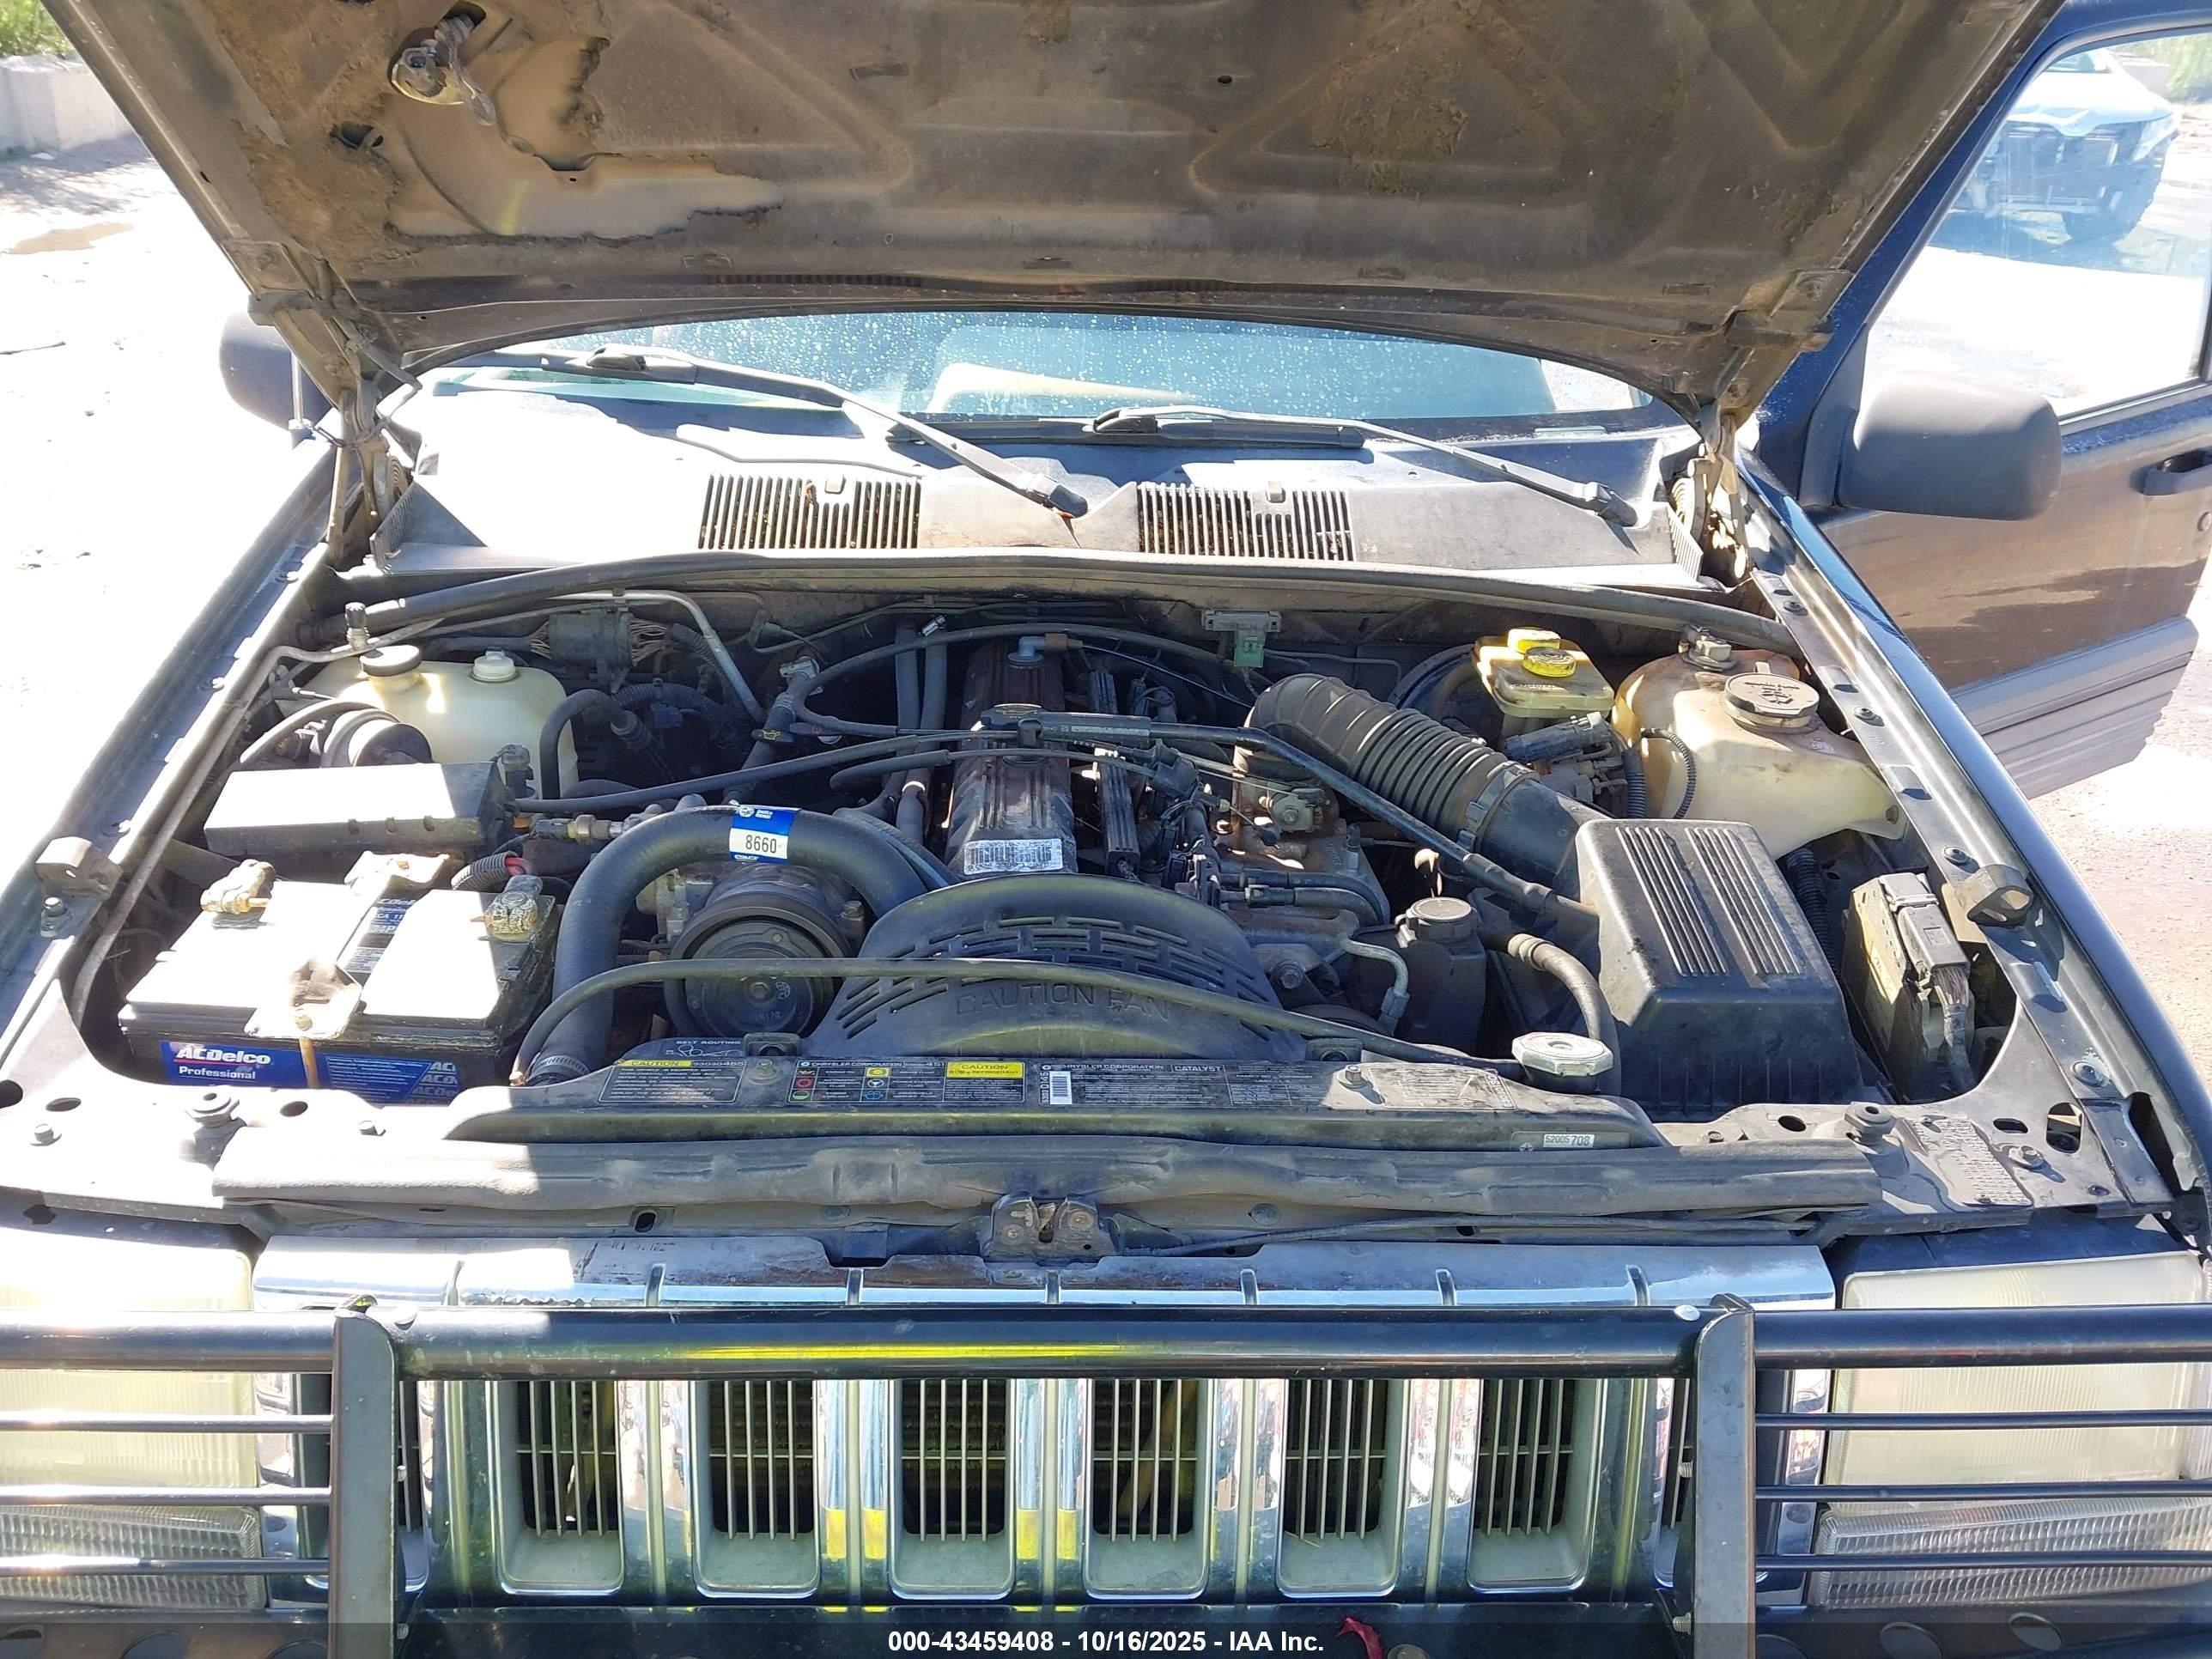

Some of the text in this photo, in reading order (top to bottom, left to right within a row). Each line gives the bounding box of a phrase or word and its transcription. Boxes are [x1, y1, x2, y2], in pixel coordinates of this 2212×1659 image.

[745, 834, 777, 854] 8660
[955, 983, 1095, 1017] CAUTION
[175, 1048, 272, 1065] ACDelco
[179, 1066, 256, 1079] Professional
